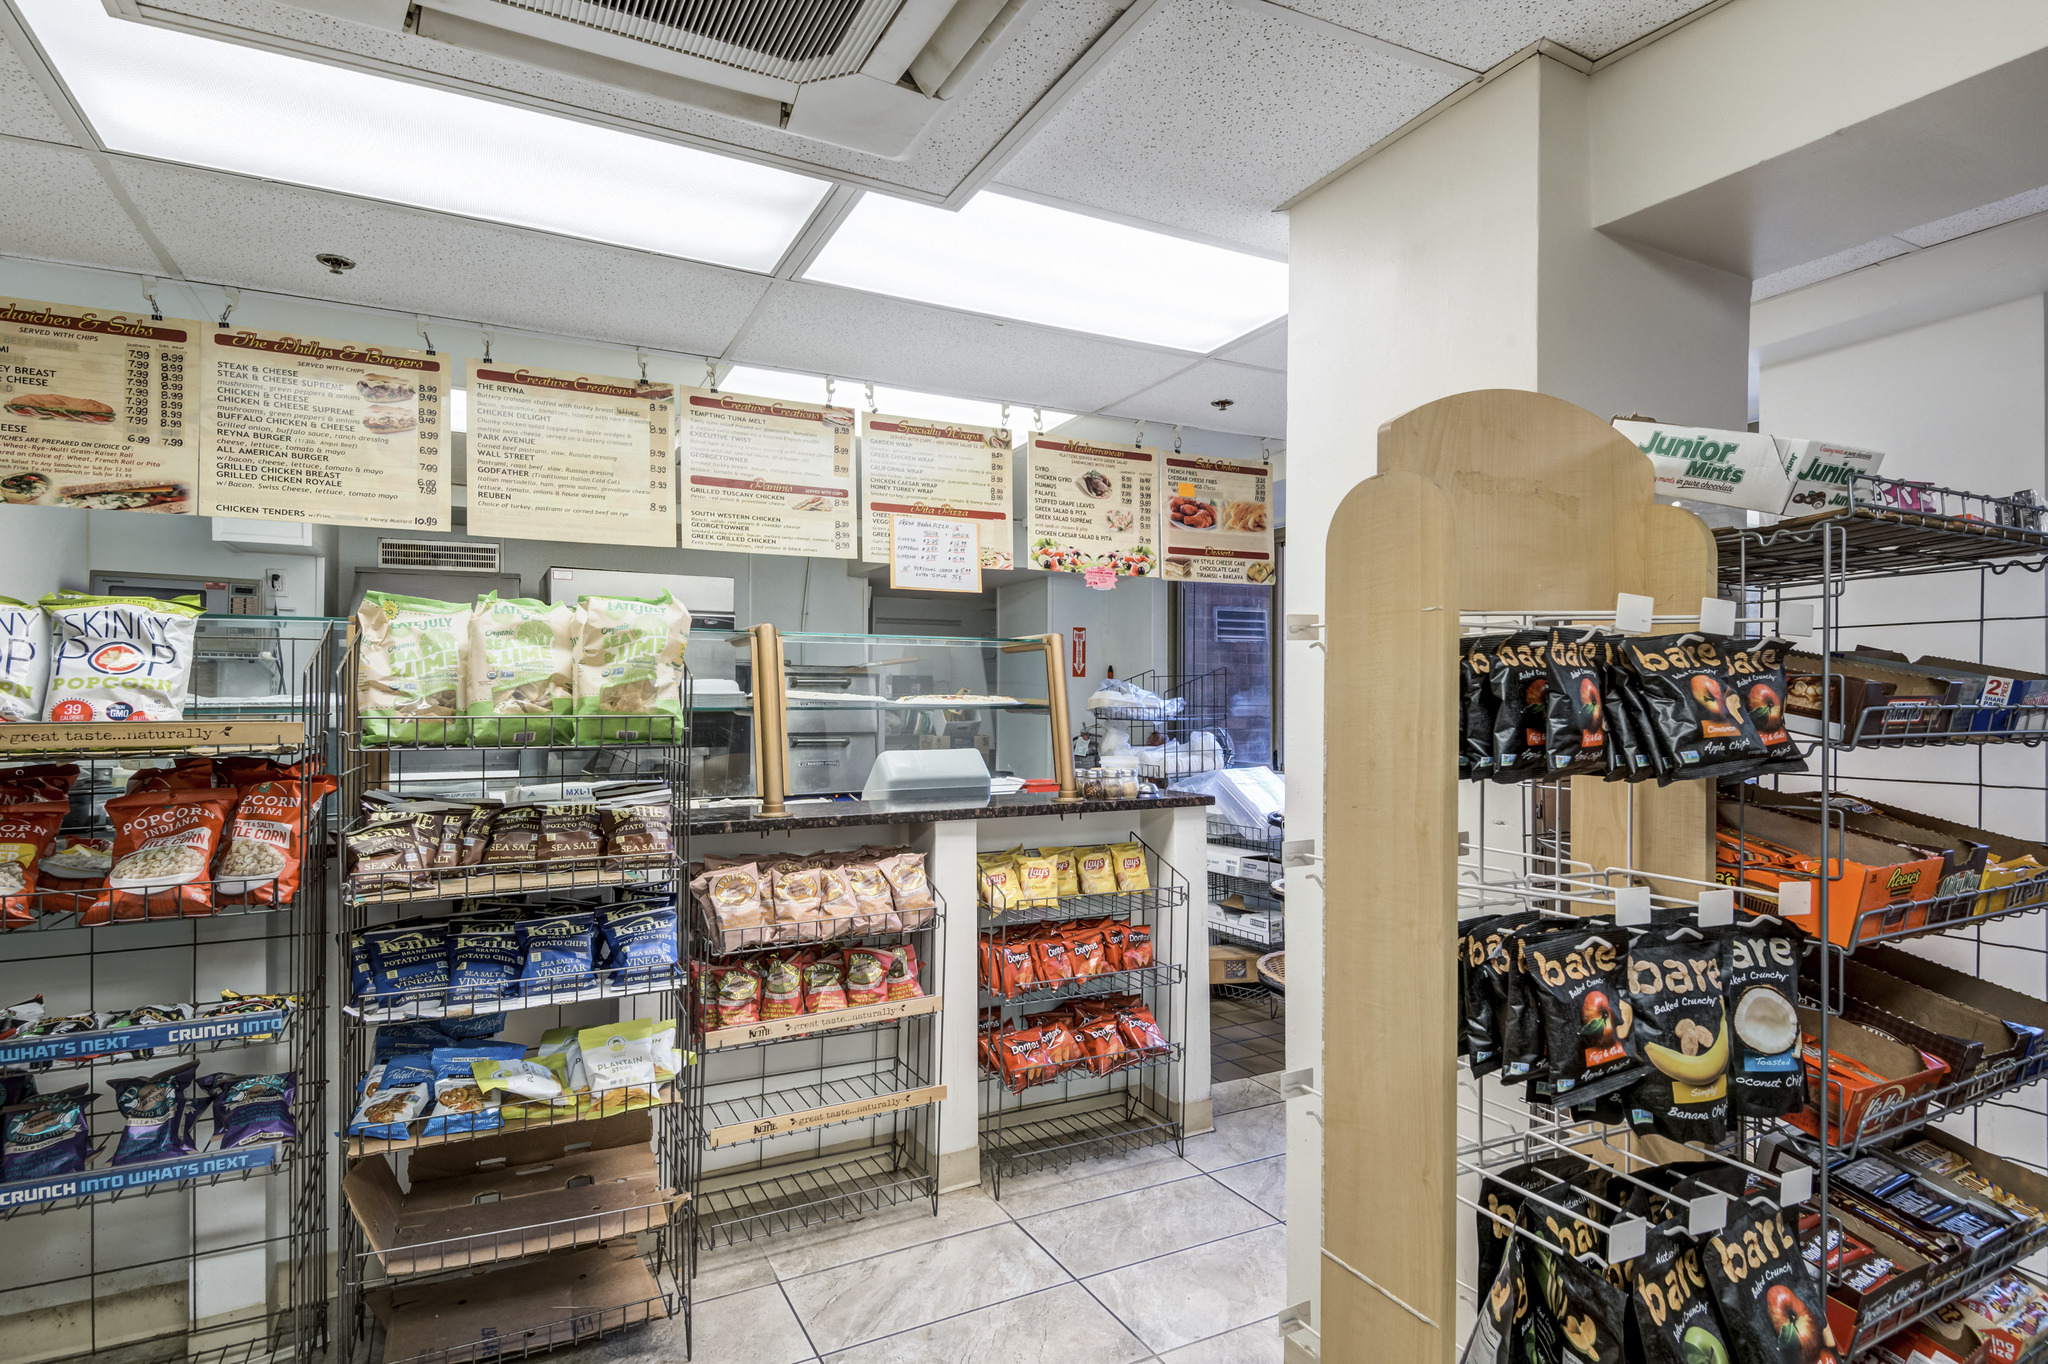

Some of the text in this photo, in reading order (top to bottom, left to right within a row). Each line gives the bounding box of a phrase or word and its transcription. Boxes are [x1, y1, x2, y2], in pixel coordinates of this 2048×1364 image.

[78, 314, 101, 330] &
[108, 316, 152, 336] Subs
[19, 327, 98, 341] SERVED WITH CHIPS
[129, 350, 183, 362] 7.99 8.99
[233, 331, 423, 369] The Phillys & Burgers
[15, 366, 56, 378] BREAST
[128, 360, 183, 372] 7.99 8.99
[218, 361, 248, 372] STEAK
[263, 367, 298, 377] CHEESE
[298, 361, 324, 369] SERVED
[7, 376, 48, 386] CHEESE
[514, 369, 632, 396] Creative Creations
[497, 385, 524, 395] REYNA
[720, 396, 820, 420] Creative Creations
[218, 412, 262, 423] BUFFALO
[266, 416, 306, 427] CHICKEN
[321, 422, 355, 432] CHEESE
[690, 410, 725, 419] TEMPTING
[728, 414, 747, 422] TUNA
[217, 429, 291, 442] REYNA BURGER
[898, 420, 979, 442] Specialty Wraps
[128, 435, 150, 444] 6.99
[477, 433, 535, 445] PARK AVENUE
[217, 446, 328, 461] ALL AMERICAN BURGER
[1063, 440, 1125, 458] Mediterranean
[1639, 431, 1740, 464] Junior
[477, 450, 534, 461] WALL STREET
[217, 462, 340, 478] GRILLED CHICKEN BREAST
[477, 467, 529, 477] GODFATHER
[1195, 458, 1240, 472] Side Orders
[1684, 460, 1746, 483] Mints
[217, 471, 342, 487] GRILLED CHICKEN ROYALE
[750, 477, 792, 492] Paninis
[1677, 477, 1734, 493] in pure chocolate
[478, 491, 511, 500] REUBEN
[691, 487, 720, 495] GRILLED
[723, 490, 753, 498] TUSCANY
[216, 504, 305, 517] CHICKEN TENDERS
[717, 512, 749, 520] WESTERN
[911, 502, 968, 517] Pita Pizza
[415, 517, 437, 526] 10.99
[1205, 546, 1234, 556] Desserts
[64, 607, 172, 642] SKINNY
[55, 638, 176, 676] POP
[1632, 643, 1721, 671] bare
[52, 677, 172, 692] POPCORN
[1986, 679, 2000, 695] 2
[2001, 681, 2010, 697] PIECE
[110, 708, 129, 718] GMO
[10, 731, 58, 744] great
[1704, 738, 1750, 754] Apple Chips
[123, 807, 215, 835] POPCORN
[143, 816, 199, 838] INDIANA
[574, 842, 597, 850] SALT
[1085, 858, 1104, 870] Lay's
[1028, 867, 1049, 879] Lay's
[531, 940, 562, 948] POTATO
[1075, 942, 1098, 956] Doritos
[384, 957, 419, 967] POTATO
[1533, 946, 1617, 987] bare
[536, 964, 587, 977] VINEGAR
[1654, 997, 1718, 1014] Baked Crunchy
[794, 1021, 819, 1032] great
[1, 1018, 282, 1061] WHAT'S NEXT CRUNCH INTO
[1011, 1041, 1040, 1055] Doritos
[597, 1056, 643, 1072] PLANTAIN
[1756, 1057, 1790, 1066] Toasted
[1691, 1087, 1716, 1097] Simply
[1668, 1108, 1709, 1120] Banana
[0, 1155, 249, 1206] CRUNCH INTO WHAT'S NEXT
